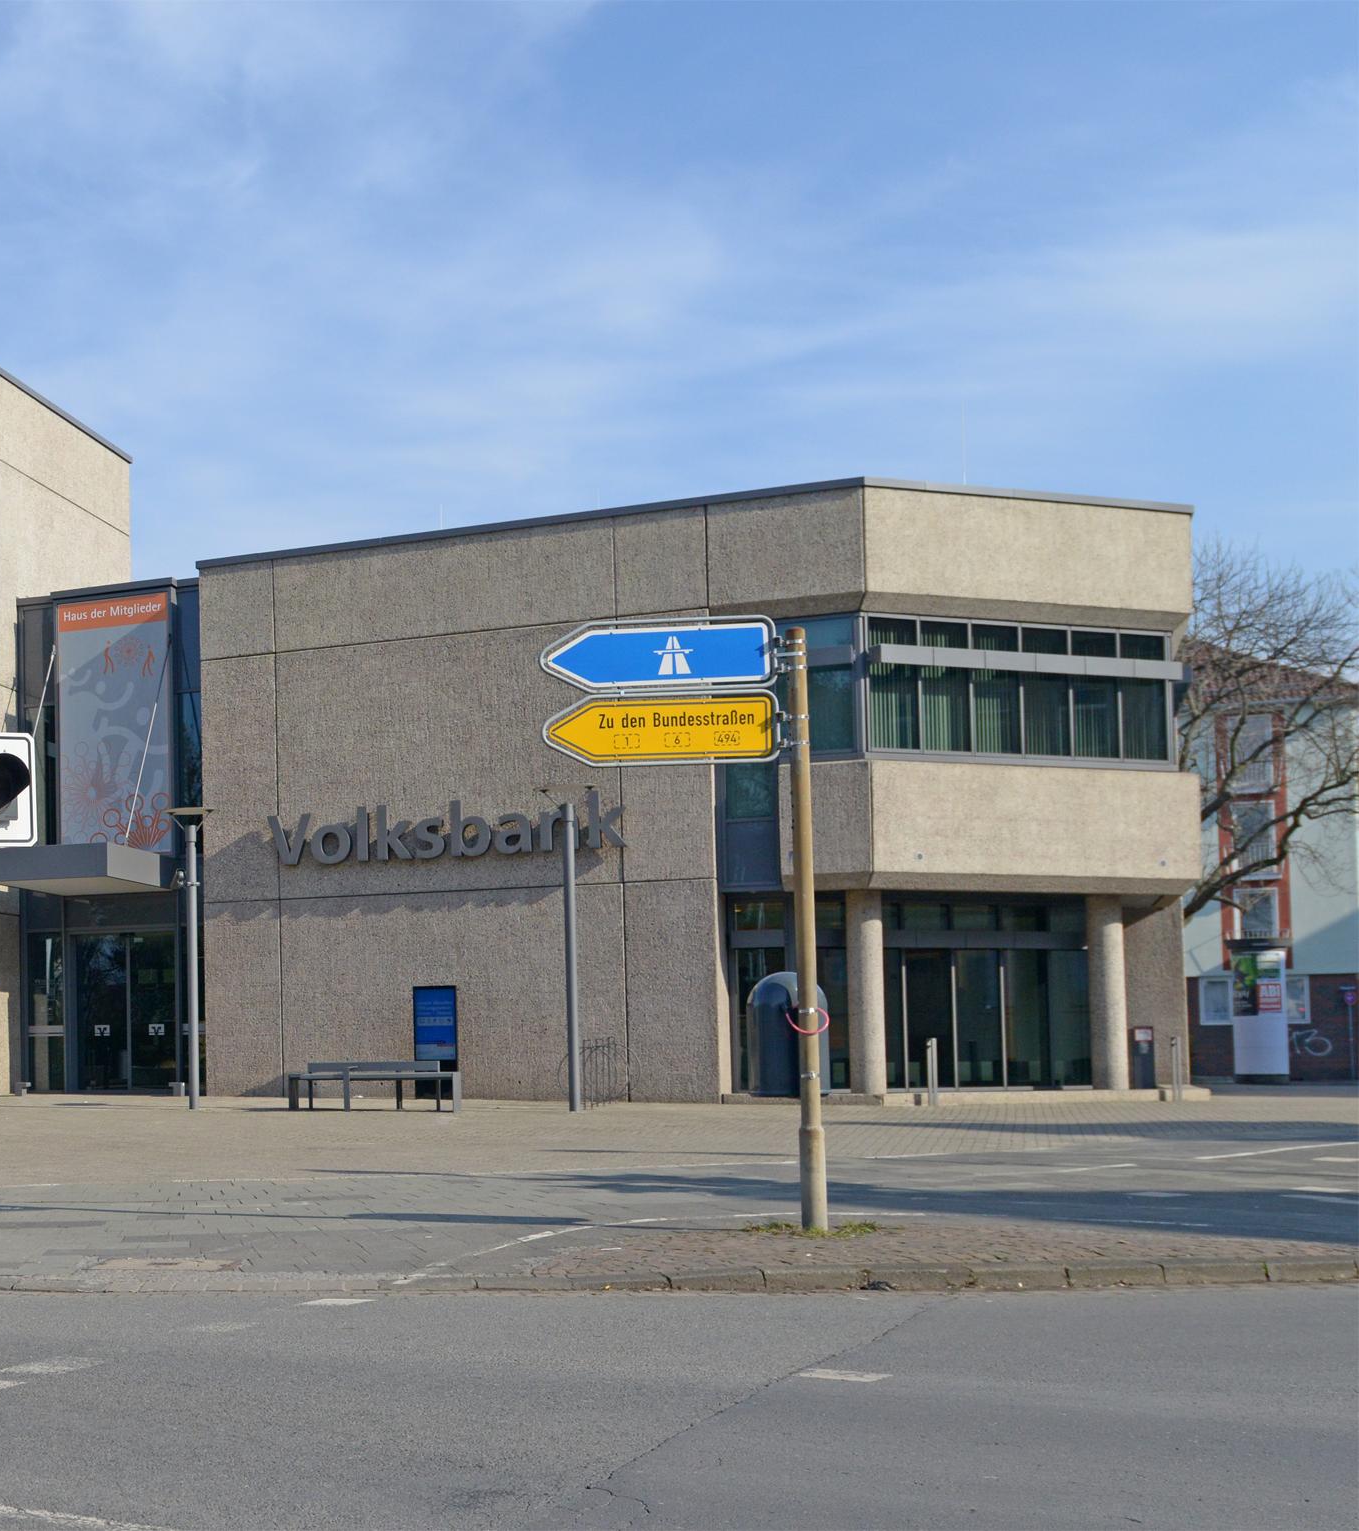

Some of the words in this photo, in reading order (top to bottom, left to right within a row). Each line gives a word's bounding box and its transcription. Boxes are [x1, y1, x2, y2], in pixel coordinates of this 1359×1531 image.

[63, 611, 88, 622] Haus
[90, 608, 107, 619] der
[110, 602, 162, 618] Mitglieder
[598, 713, 614, 729] Zu
[621, 713, 646, 728] den
[653, 710, 755, 728] Bundesstraßen
[673, 734, 681, 745] 6
[717, 733, 737, 744] 494
[267, 790, 627, 866] Volksbank
